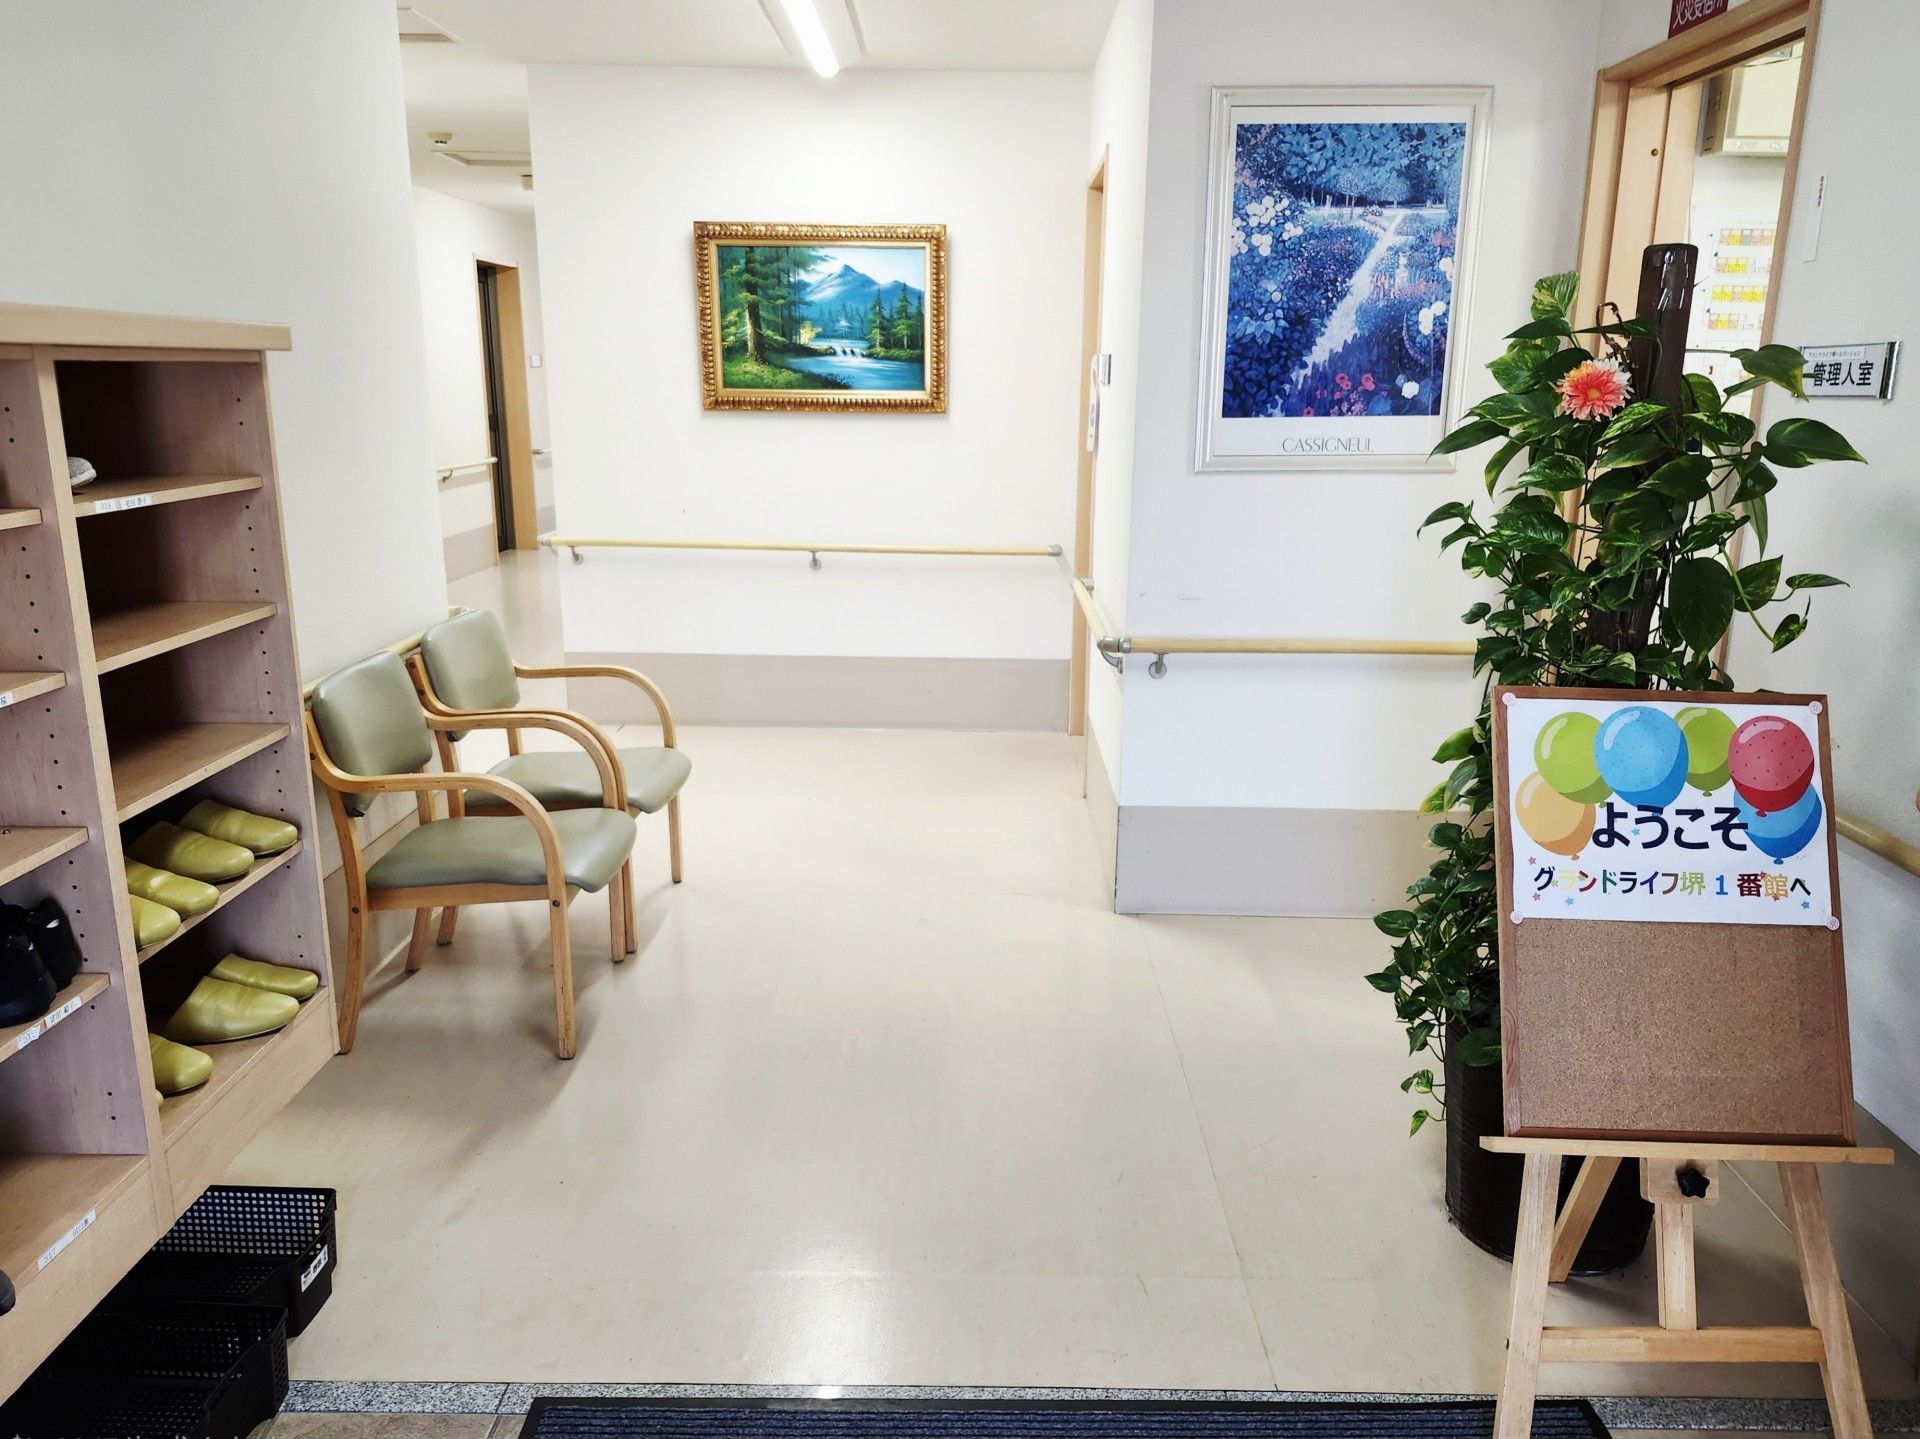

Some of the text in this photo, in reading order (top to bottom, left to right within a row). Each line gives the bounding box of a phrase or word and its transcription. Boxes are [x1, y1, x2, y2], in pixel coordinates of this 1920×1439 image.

[1813, 360, 1874, 387] 管理人室
[1282, 436, 1375, 454] CASSIGNEUL
[1592, 801, 1749, 851] ようこそ
